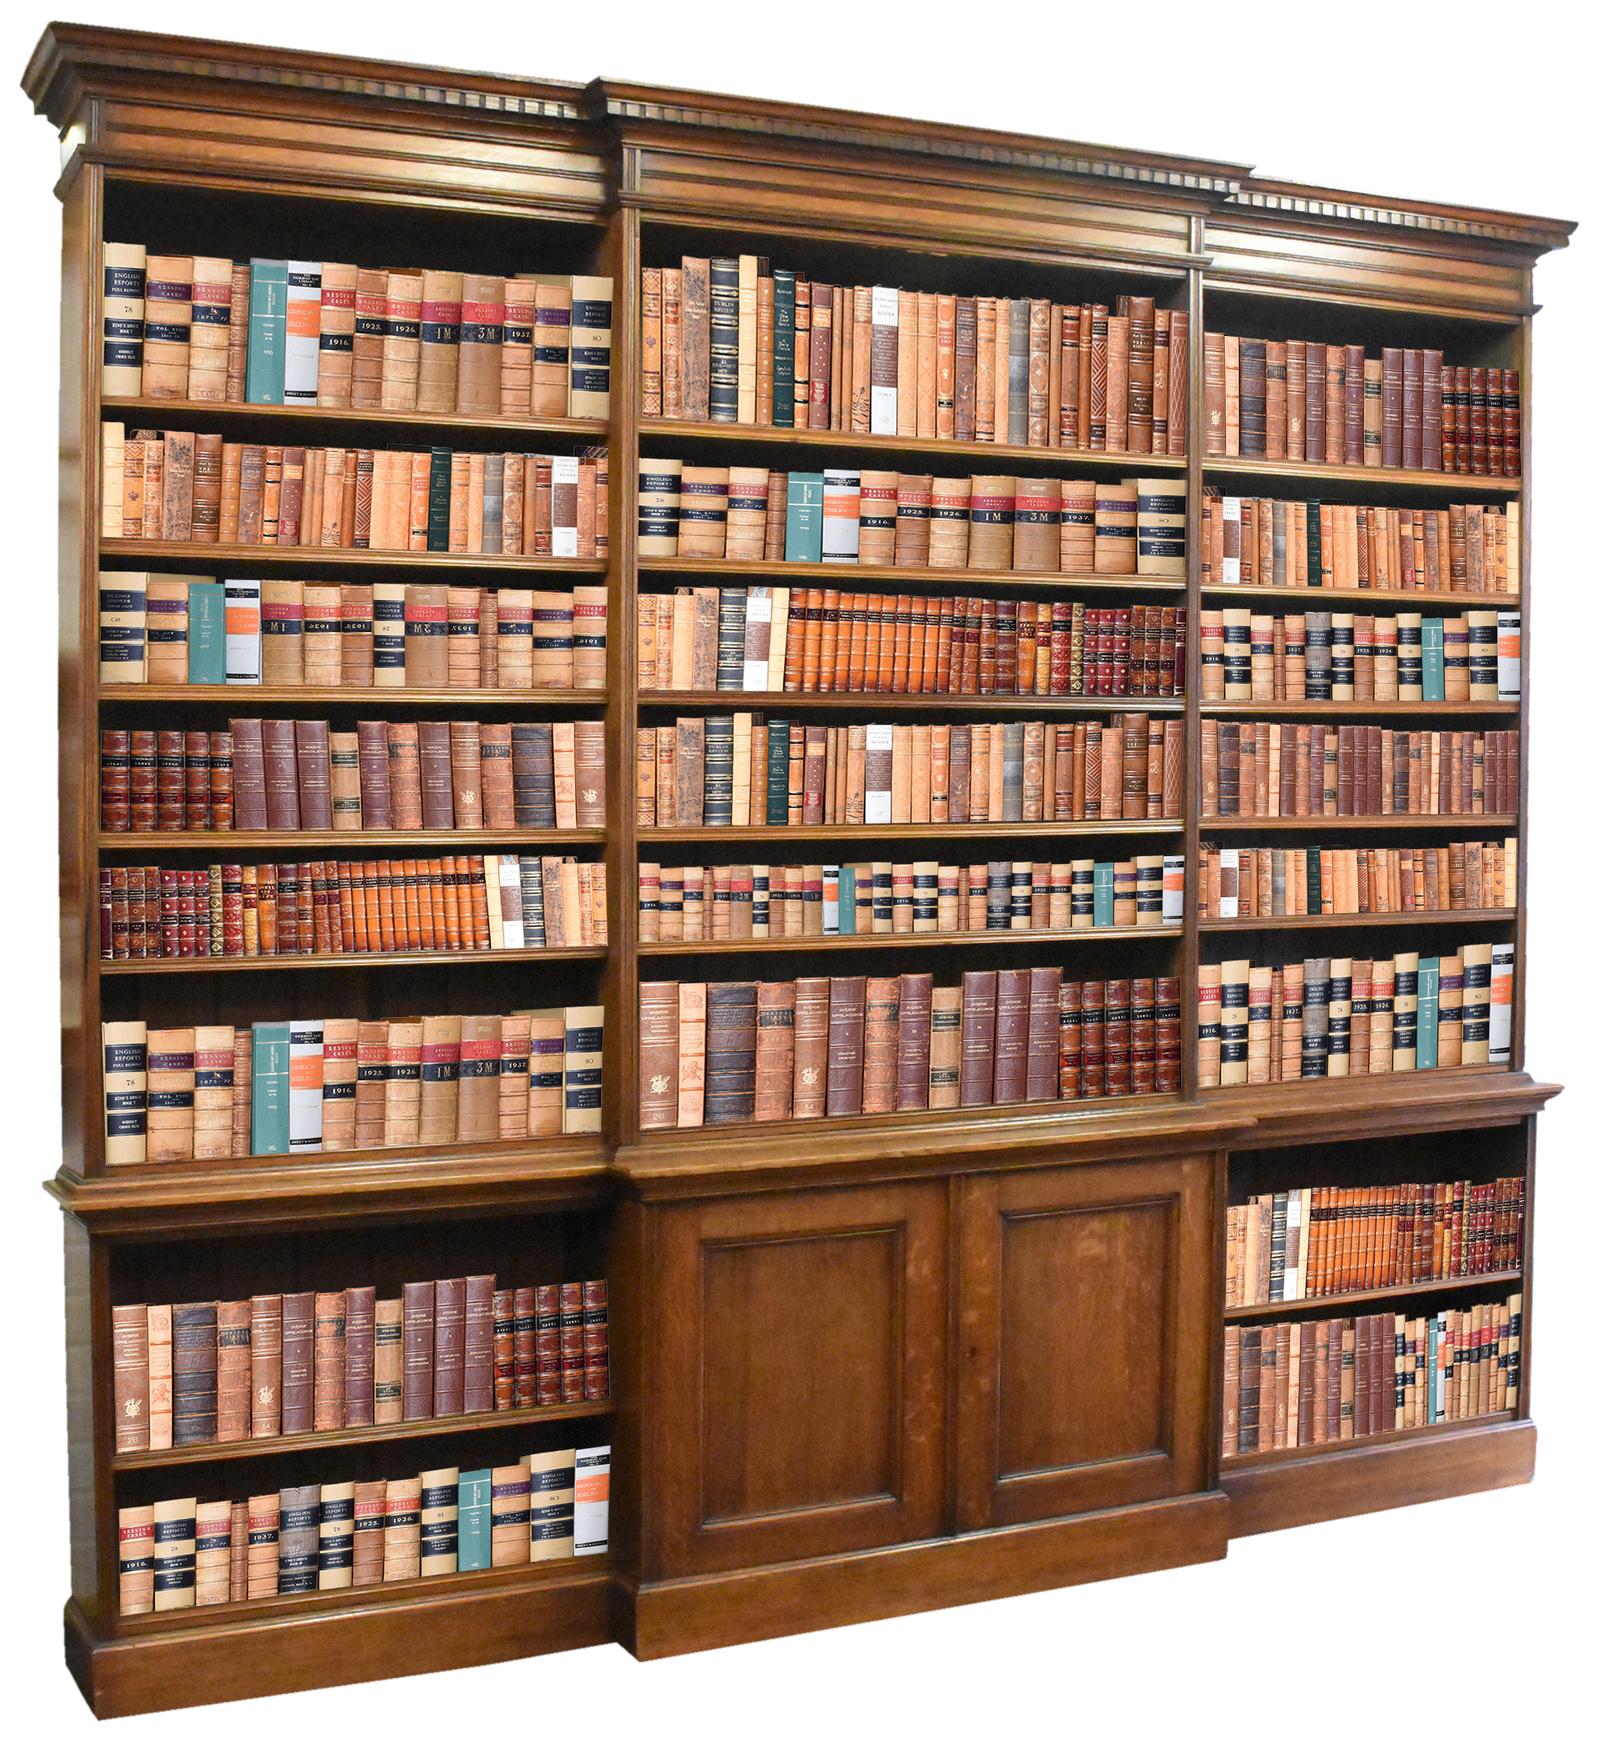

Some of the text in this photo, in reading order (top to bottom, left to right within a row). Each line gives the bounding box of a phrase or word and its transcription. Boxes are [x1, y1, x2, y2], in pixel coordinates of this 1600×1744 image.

[992, 512, 1001, 521] M
[1030, 513, 1048, 521] 3 M
[477, 1061, 485, 1073] 3
